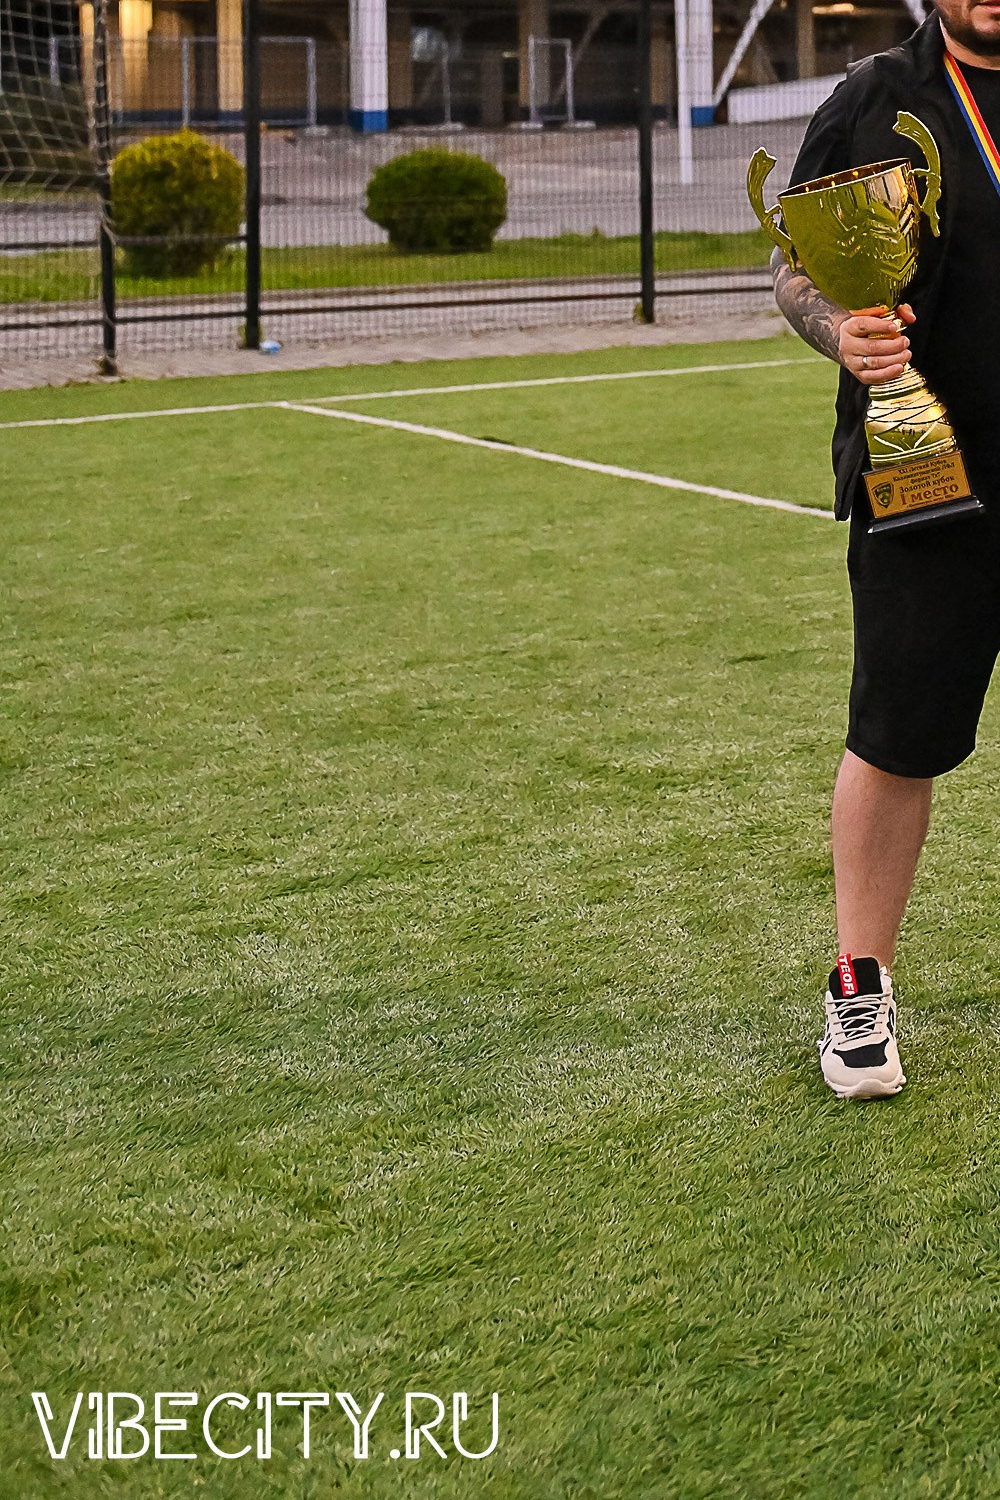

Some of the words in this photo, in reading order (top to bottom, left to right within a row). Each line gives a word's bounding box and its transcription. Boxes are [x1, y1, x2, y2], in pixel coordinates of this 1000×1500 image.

[898, 480, 931, 494] Золотой
[932, 475, 955, 487] кубок
[910, 483, 959, 503] место
